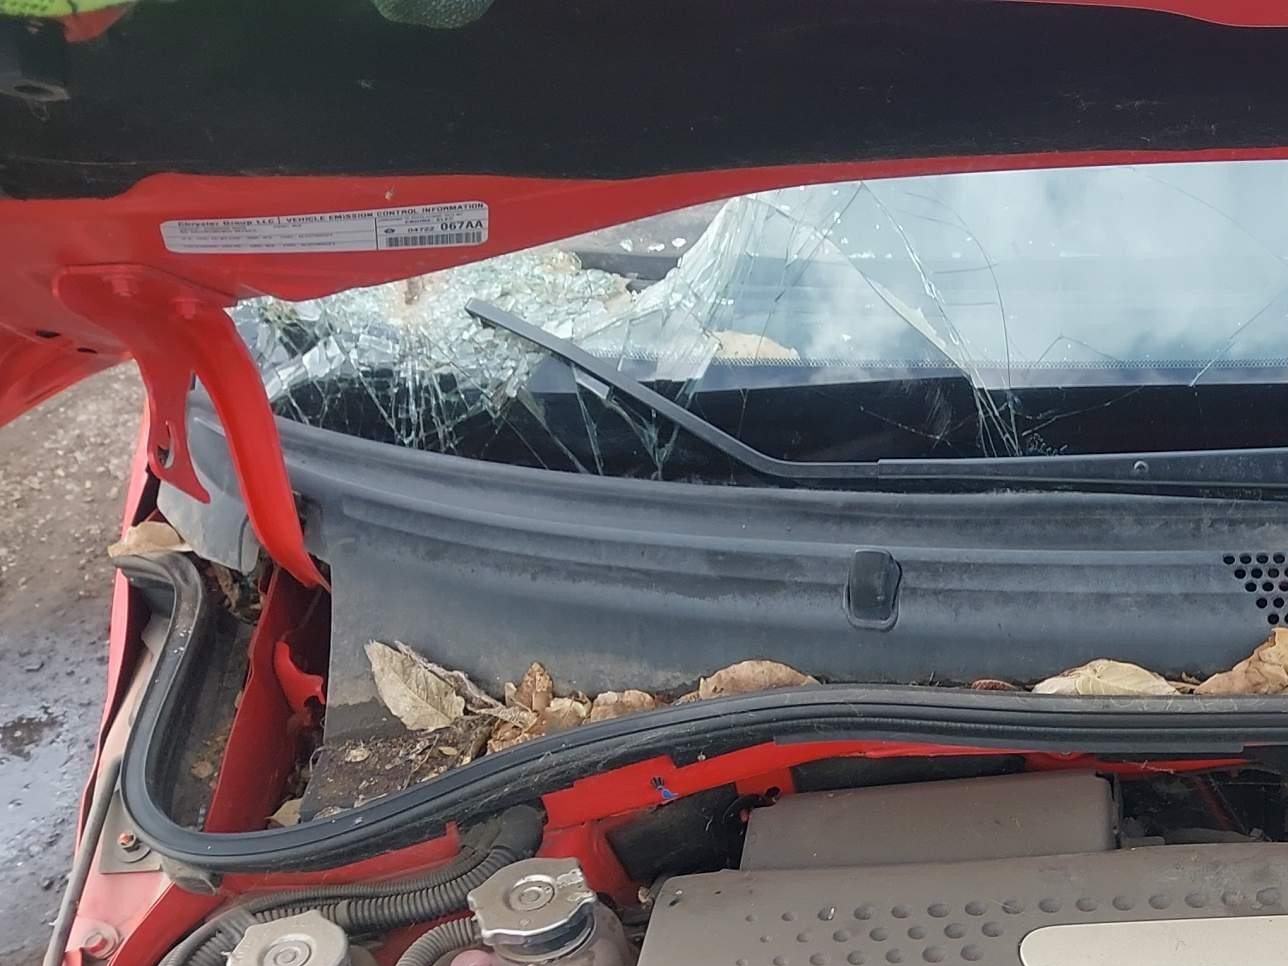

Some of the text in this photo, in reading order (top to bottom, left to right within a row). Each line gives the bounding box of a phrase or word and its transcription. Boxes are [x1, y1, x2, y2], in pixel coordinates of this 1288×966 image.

[286, 216, 324, 224] VEHICLE
[328, 212, 373, 221] EMISSION
[377, 209, 417, 217] CONTROL
[422, 203, 483, 213] INFORMATION
[440, 220, 484, 231] 067AA
